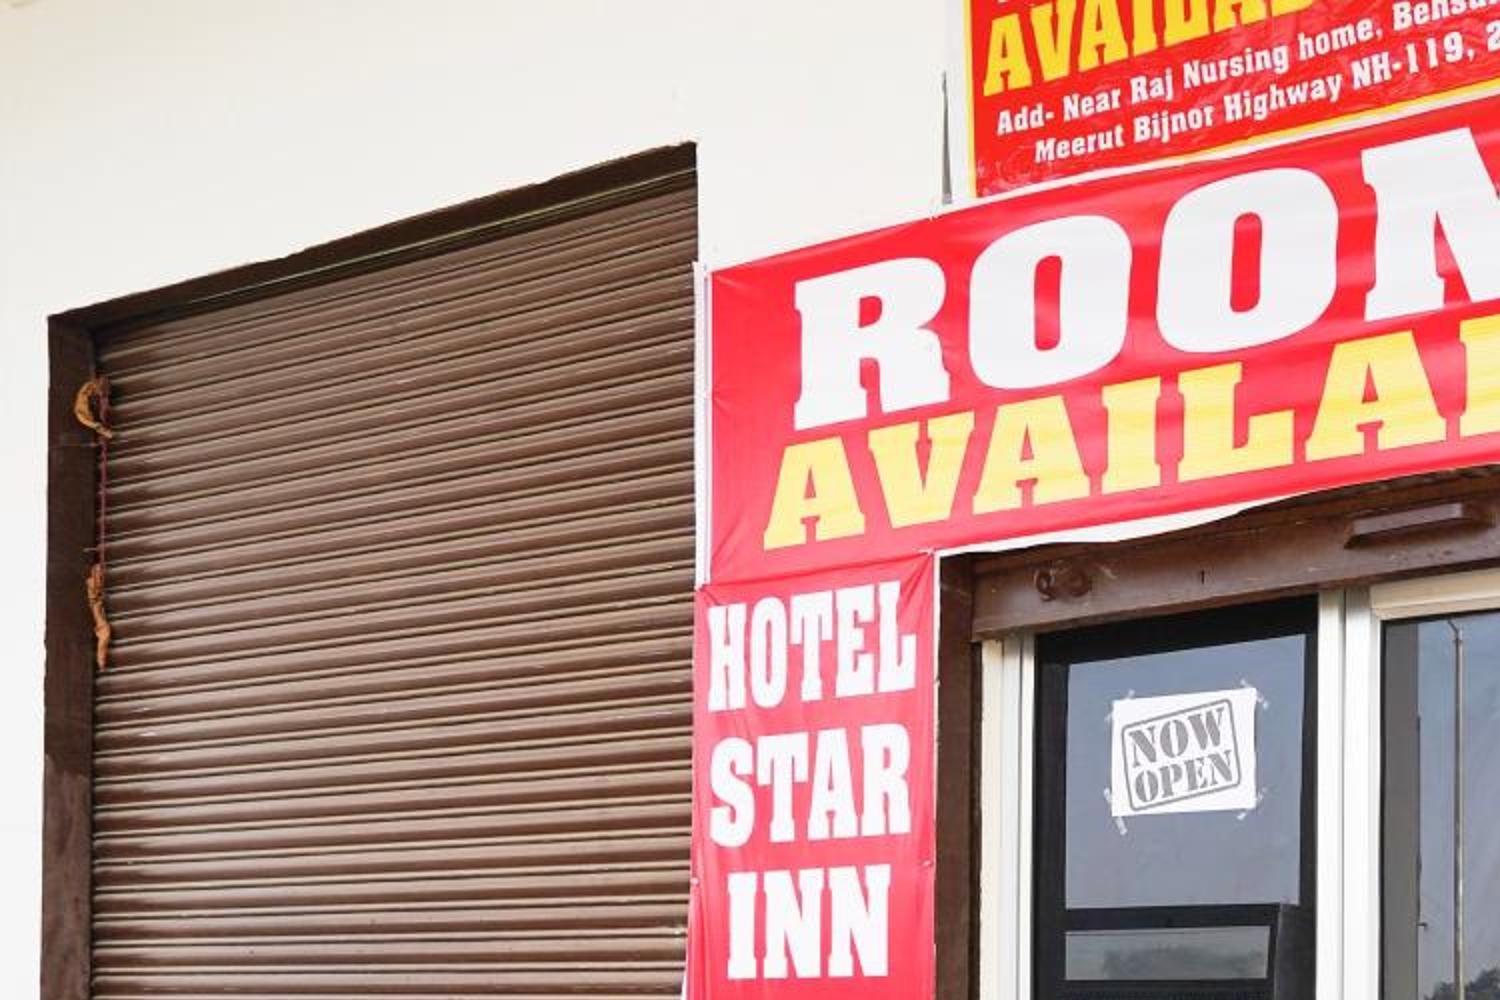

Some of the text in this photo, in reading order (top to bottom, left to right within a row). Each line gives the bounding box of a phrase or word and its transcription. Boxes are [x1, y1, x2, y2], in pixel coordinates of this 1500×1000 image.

[997, 103, 1054, 135] Add-
[1063, 90, 1121, 121] Near
[1130, 67, 1174, 104] Raj
[1183, 45, 1289, 89] Nursing
[1298, 18, 1382, 61] home,
[1035, 125, 1124, 163] Meerut
[1134, 105, 1213, 143] Bijnor
[1223, 73, 1343, 122] Highway
[1351, 31, 1475, 90] NH-119,
[707, 580, 918, 712] HOTEL
[709, 723, 912, 848] STAR
[1128, 706, 1225, 768] NOW
[1134, 749, 1233, 803] OPEN
[726, 863, 891, 981] INN
